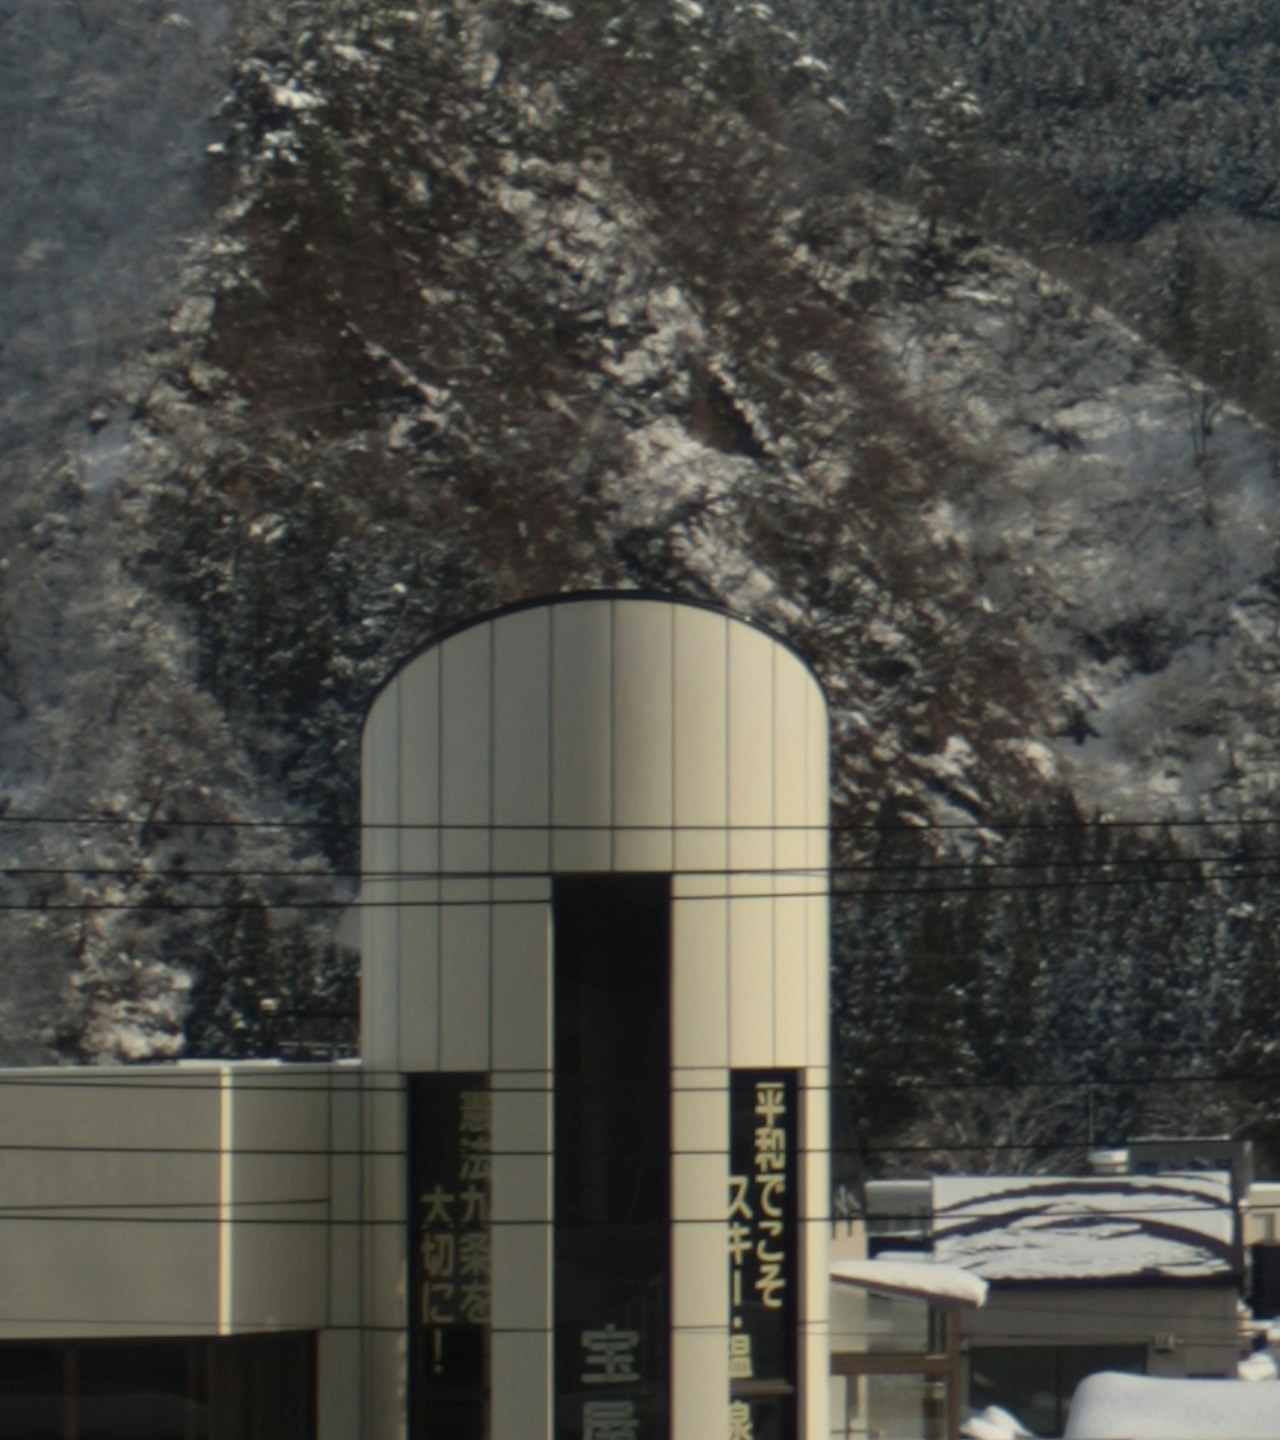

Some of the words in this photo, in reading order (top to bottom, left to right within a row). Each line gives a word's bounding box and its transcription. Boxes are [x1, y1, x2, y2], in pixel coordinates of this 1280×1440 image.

[754, 1081, 786, 1309] 平和でこそ
